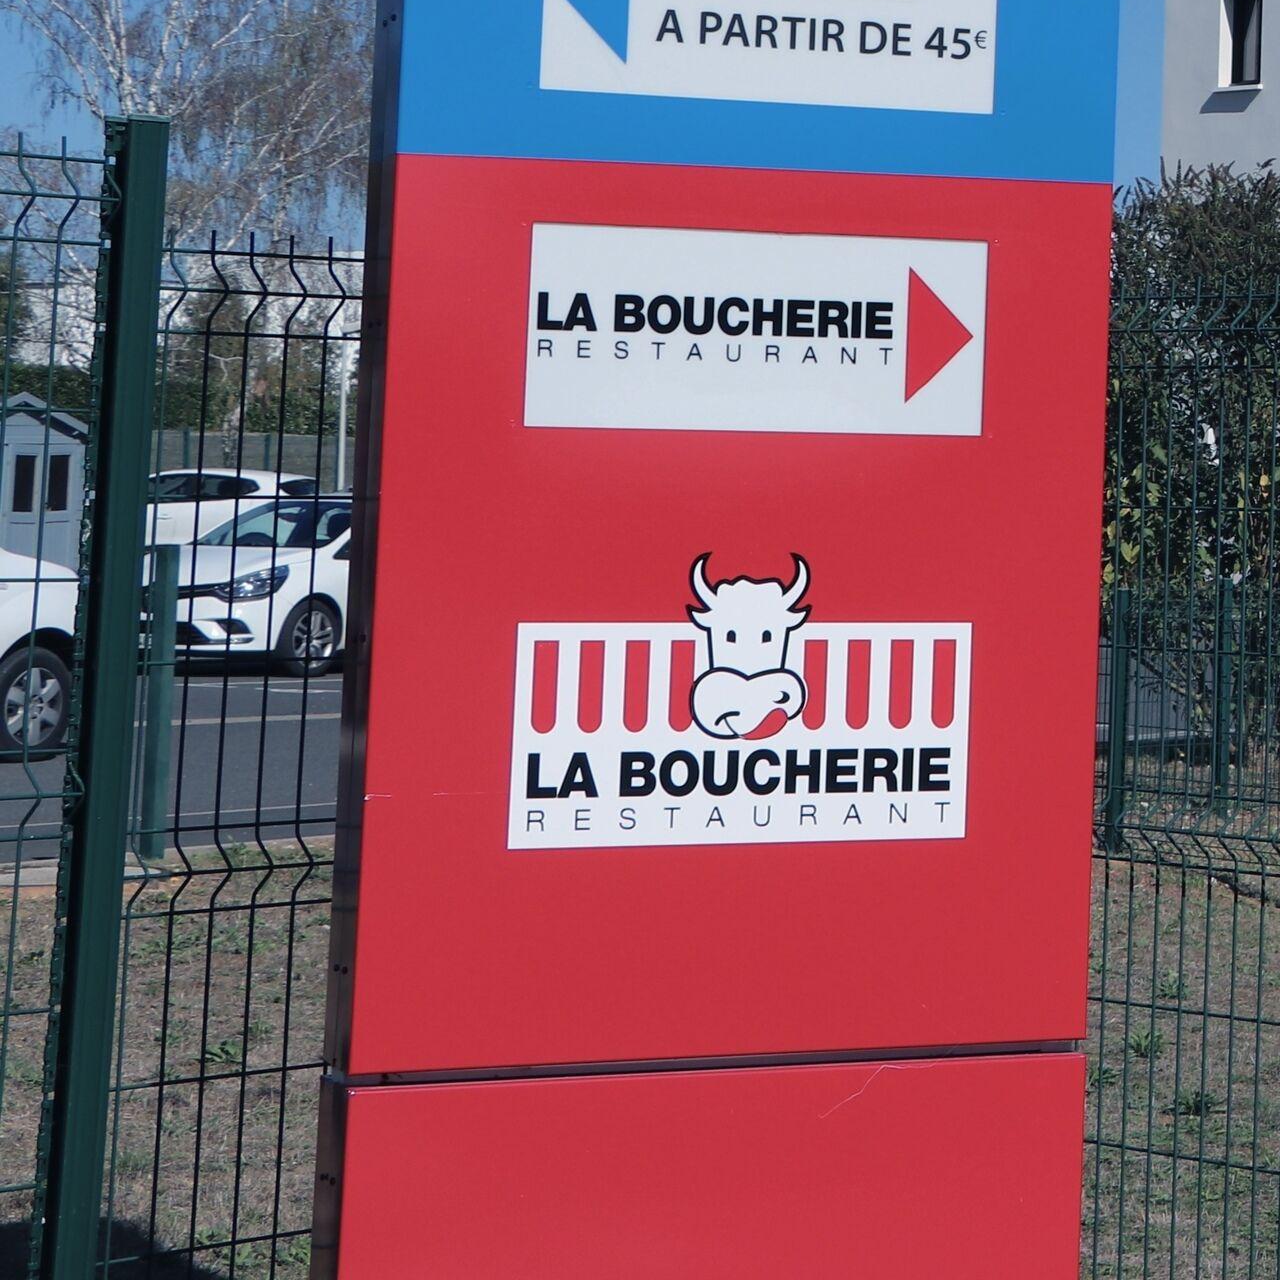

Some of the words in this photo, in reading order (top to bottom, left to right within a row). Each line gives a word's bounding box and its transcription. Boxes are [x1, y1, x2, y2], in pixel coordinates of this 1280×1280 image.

[655, 9, 684, 43] A
[699, 11, 844, 52] PARTIR
[859, 21, 912, 56] DE
[924, 27, 988, 60] 45€
[536, 292, 597, 333] LA
[613, 293, 893, 340] BOUCHERIE
[537, 339, 894, 367] RESTAURANT
[526, 753, 598, 799] LA
[618, 748, 951, 797] BOUCHERIE
[526, 802, 951, 833] RESTAURANT
